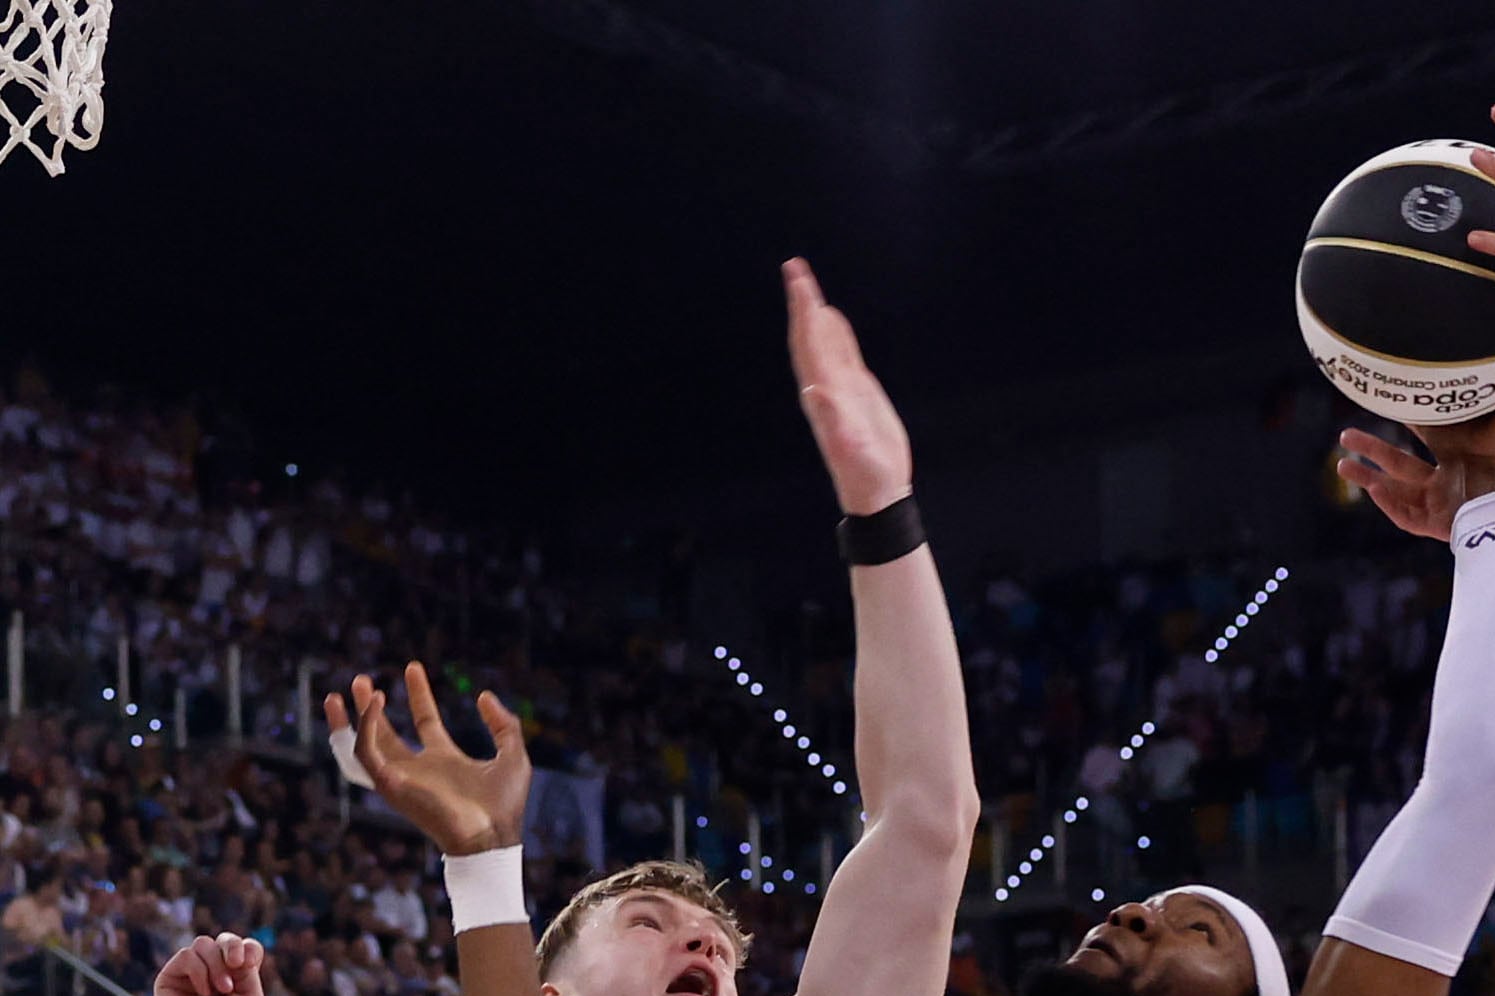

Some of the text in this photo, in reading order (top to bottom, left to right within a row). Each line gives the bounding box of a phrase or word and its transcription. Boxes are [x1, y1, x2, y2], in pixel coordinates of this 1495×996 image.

[1372, 371, 1437, 391] Canaria
[1438, 374, 1479, 389] Gran
[1374, 388, 1407, 403] del
[1435, 399, 1480, 413] acb
